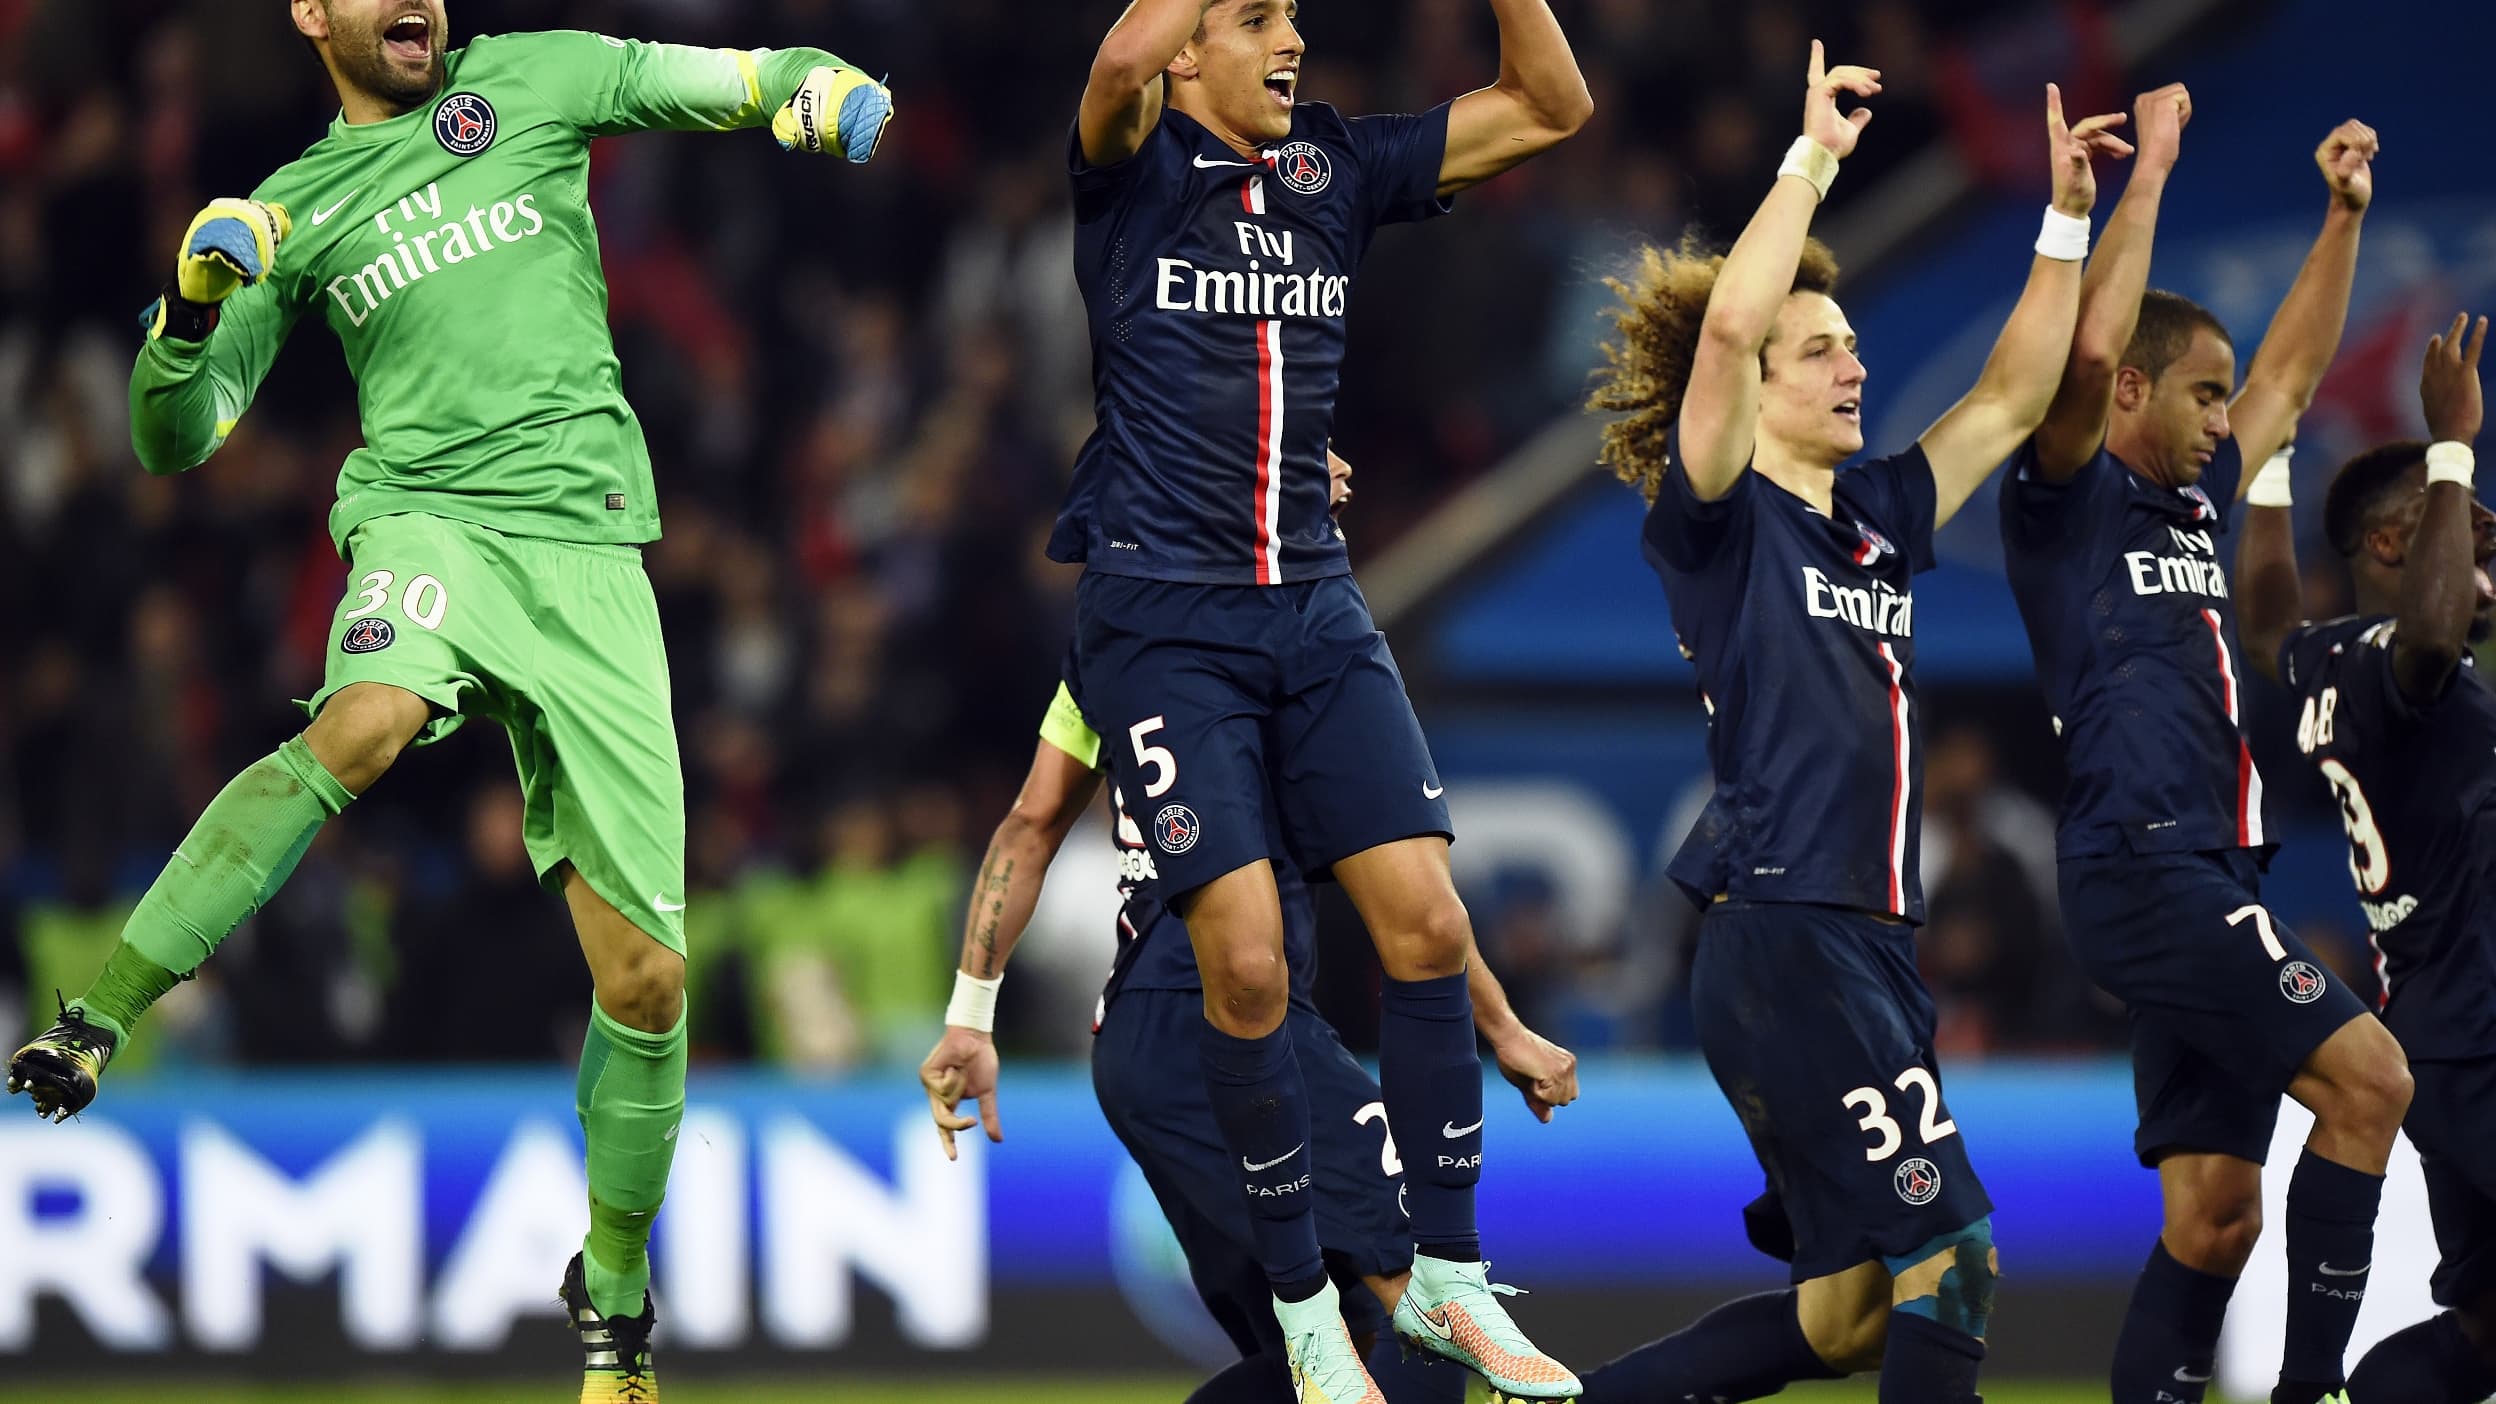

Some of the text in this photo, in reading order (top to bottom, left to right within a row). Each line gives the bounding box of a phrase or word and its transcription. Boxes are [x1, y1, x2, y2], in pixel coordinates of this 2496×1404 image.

[440, 98, 473, 121] PARIS
[1281, 144, 1317, 159] PARIS
[326, 192, 543, 328] Emirates
[1233, 221, 1293, 266] Fly
[1156, 259, 1349, 317] Emirates
[343, 569, 448, 631] 30
[1129, 714, 1177, 799] 5
[1157, 808, 1184, 825] PARIS
[2224, 904, 2288, 962] 7
[1842, 1066, 1957, 1162] 32
[1246, 1174, 1310, 1197] PARIS
[1898, 1161, 1926, 1178] PARIS
